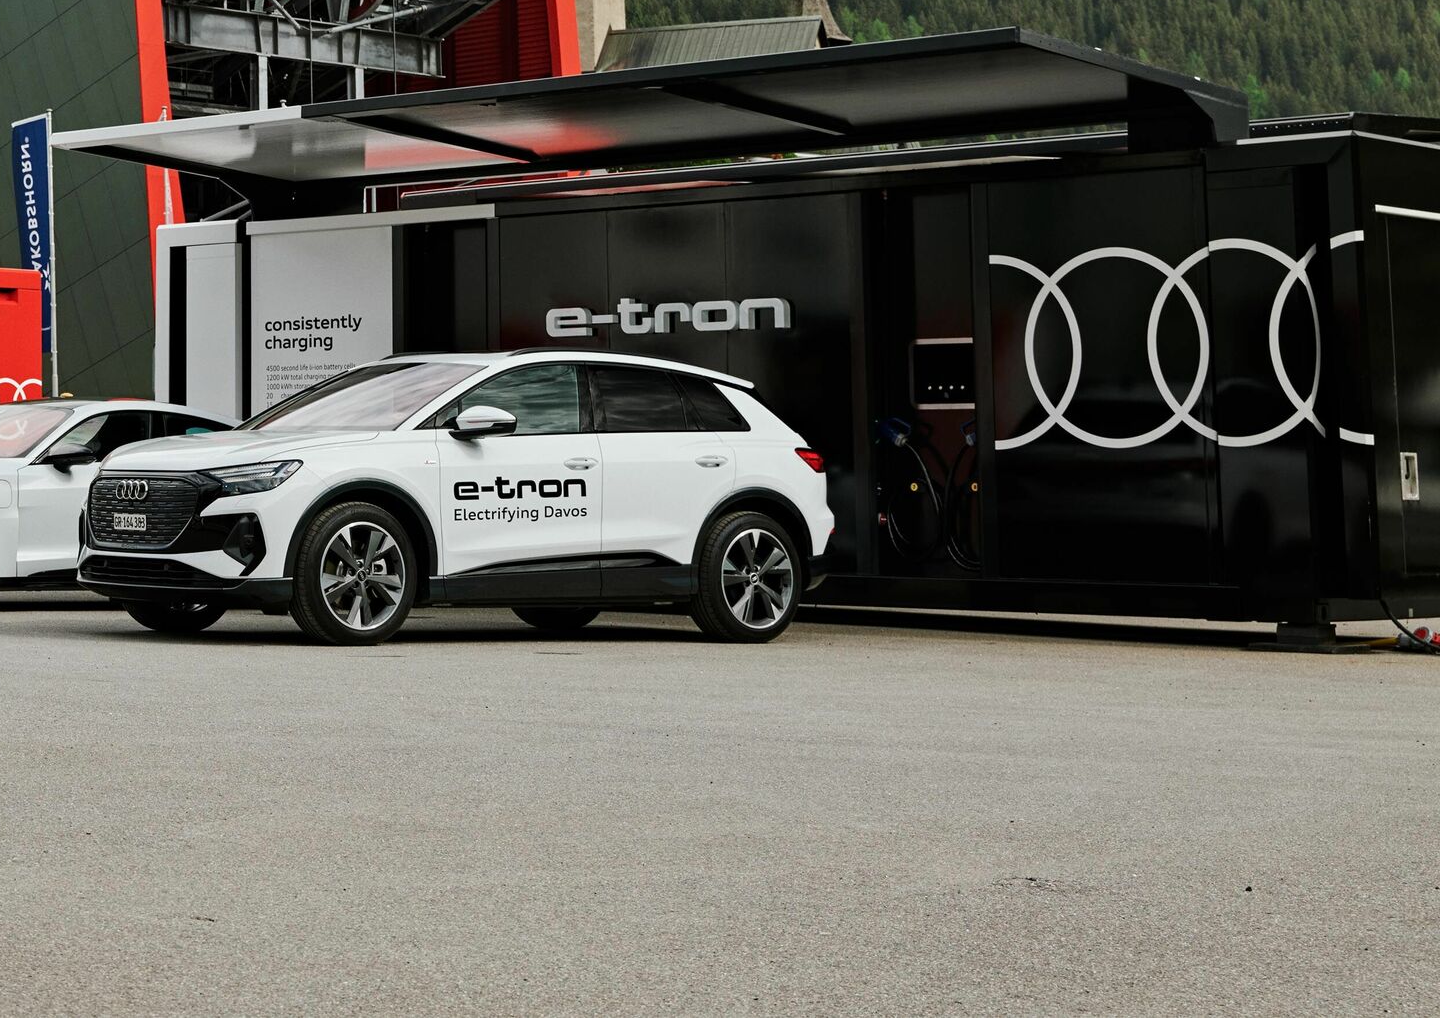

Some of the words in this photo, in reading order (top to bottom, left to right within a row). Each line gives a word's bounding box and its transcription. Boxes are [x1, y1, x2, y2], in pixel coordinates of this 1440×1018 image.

[265, 314, 362, 332] consistently
[546, 297, 791, 338] e-tron
[265, 334, 333, 352] charging
[281, 364, 299, 372] second
[324, 363, 343, 371] battery
[290, 373, 303, 381] total
[453, 476, 587, 501] e-tron
[454, 507, 539, 522] Electrifying
[544, 506, 587, 519] Davos
